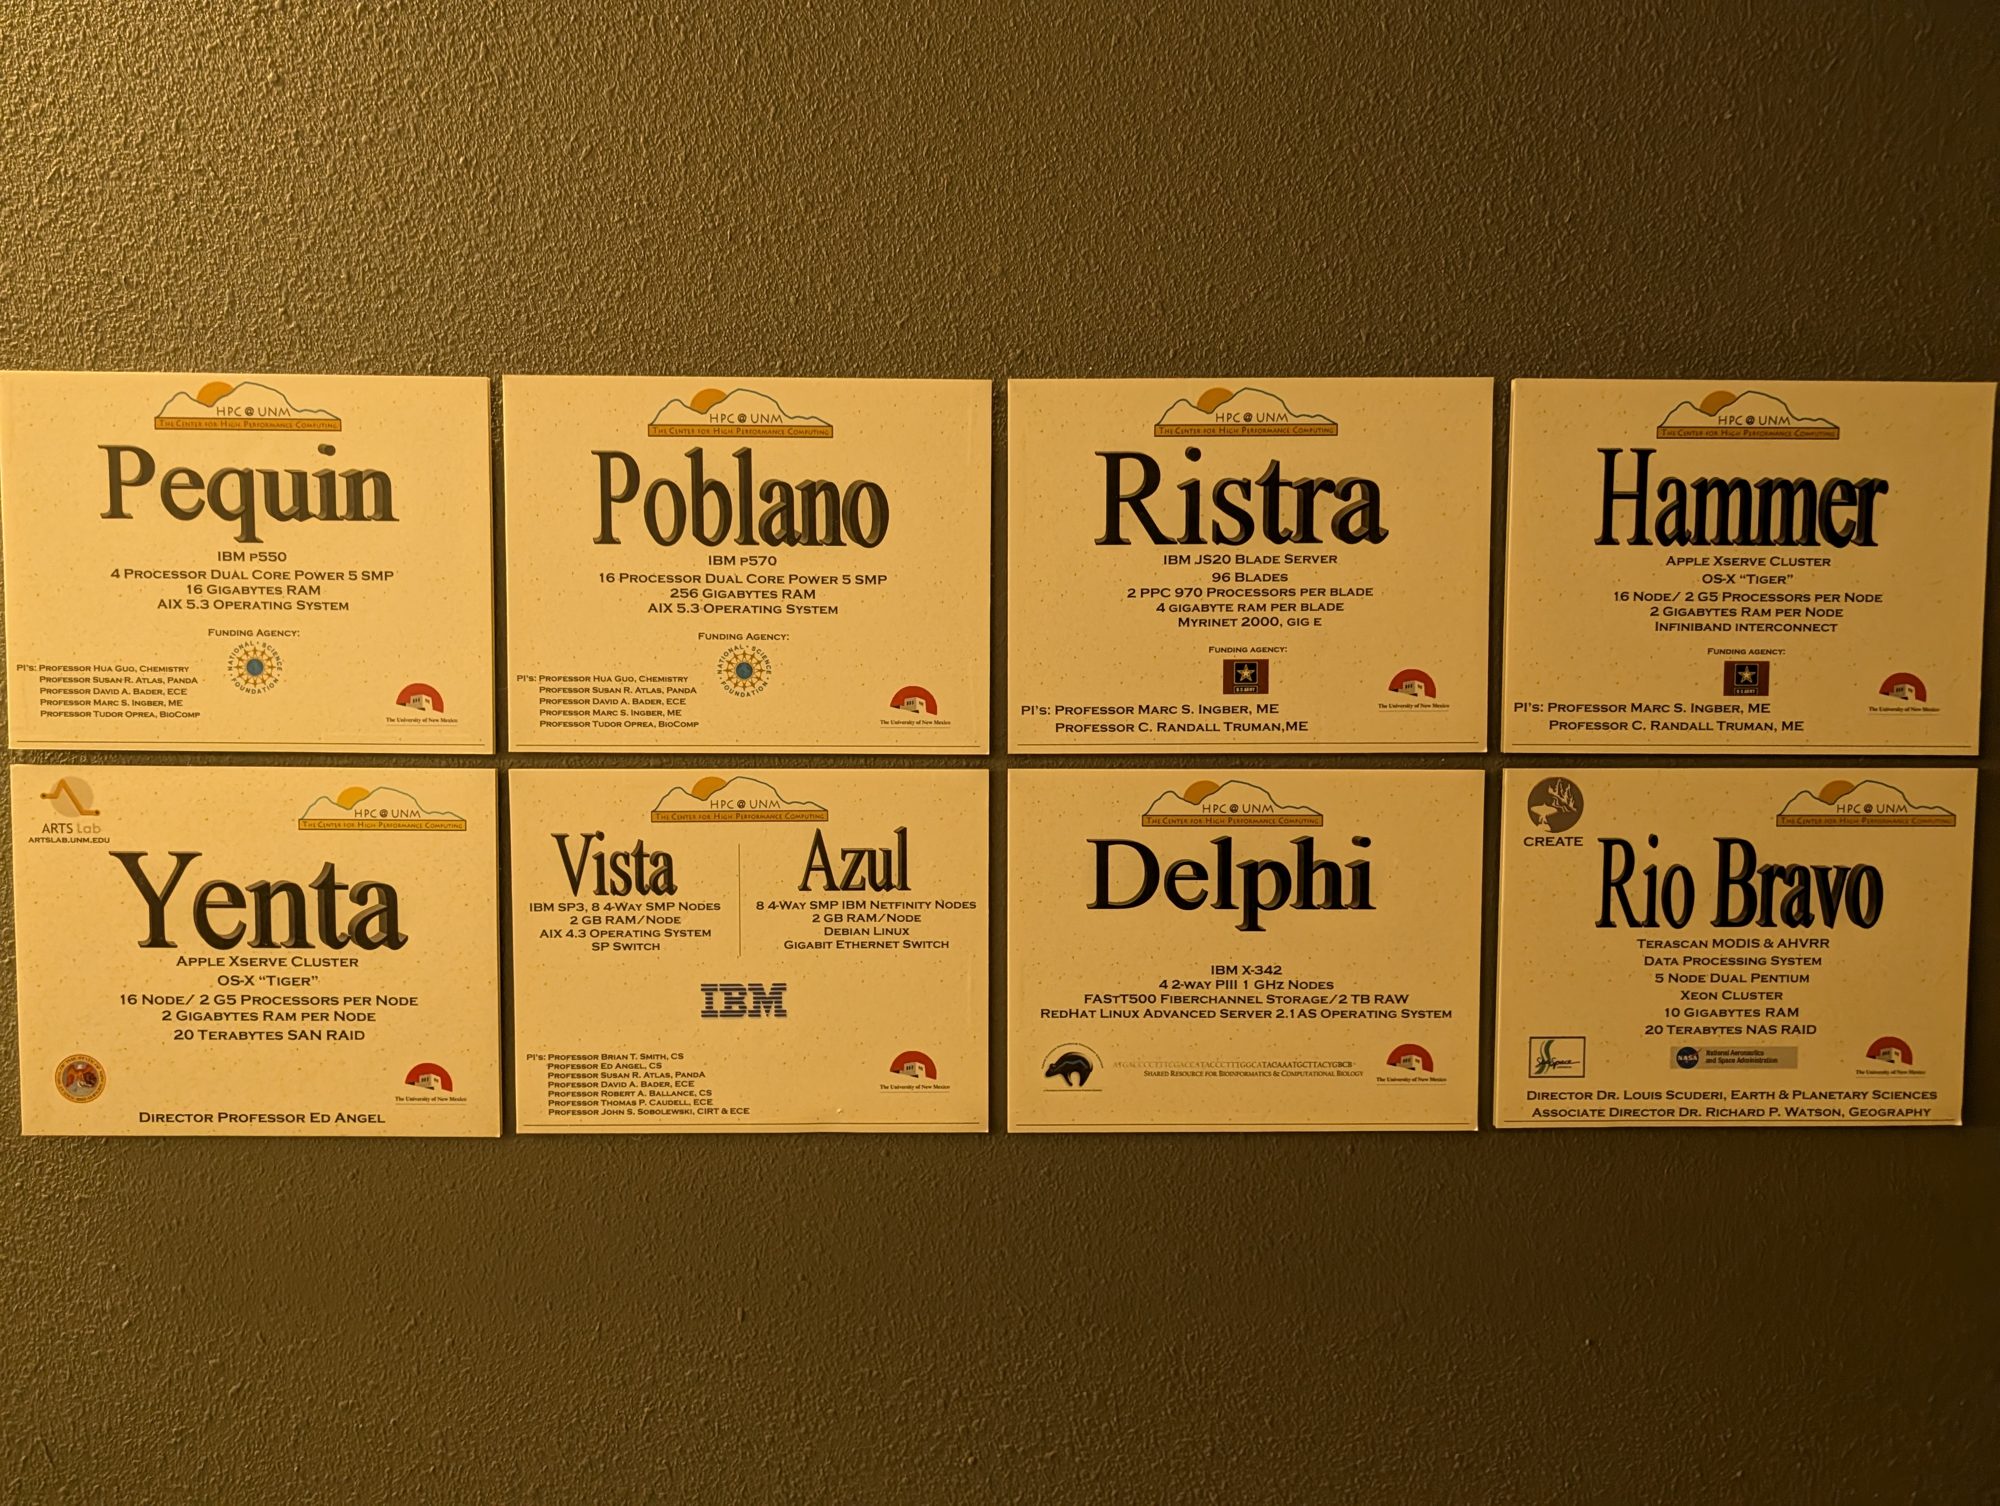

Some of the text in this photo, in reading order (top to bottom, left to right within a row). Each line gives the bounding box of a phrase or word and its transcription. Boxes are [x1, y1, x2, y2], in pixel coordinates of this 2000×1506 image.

[217, 406, 292, 417] HPC @ UNM
[98, 444, 400, 543] Pequin
[591, 447, 889, 548] Poblano
[1094, 447, 1389, 546] Ristra
[1594, 448, 1889, 548] Hammer
[218, 551, 245, 562] IBM
[1164, 555, 1190, 565] IBM
[1194, 554, 1231, 565] JS20
[110, 568, 120, 578] 4
[349, 571, 358, 581] 5
[361, 571, 394, 581] SMP
[187, 584, 203, 594] 16
[287, 585, 320, 595] RAM
[670, 588, 698, 598] 256
[782, 589, 815, 599] RAM
[648, 603, 673, 613] AIX
[677, 603, 700, 613] 5.3
[1650, 606, 1659, 616] 2
[1741, 607, 1771, 617] RAM
[1314, 618, 1322, 626] E
[1748, 703, 1770, 713] ME
[355, 808, 421, 818] HPC @ UNM
[42, 823, 101, 834] ARTS Lab
[1524, 837, 1583, 846] CREATE
[551, 831, 678, 897] Vista
[798, 826, 911, 892] Azul
[1086, 836, 1376, 932] Delphi
[1595, 834, 1883, 929] Rio Bravo
[109, 851, 408, 950] Yenta
[530, 903, 554, 912] IBM
[592, 903, 600, 911] 8
[646, 902, 675, 911] SMP
[1211, 965, 1282, 975] IBM X-342
[1159, 980, 1168, 989] 4
[1244, 980, 1248, 989] 1
[701, 983, 787, 1018] IBM
[1350, 994, 1370, 1004] TB
[1374, 994, 1409, 1004] RAW
[174, 1029, 194, 1040] 20
[288, 1030, 321, 1040] SAN
[327, 1030, 365, 1040] RAID
